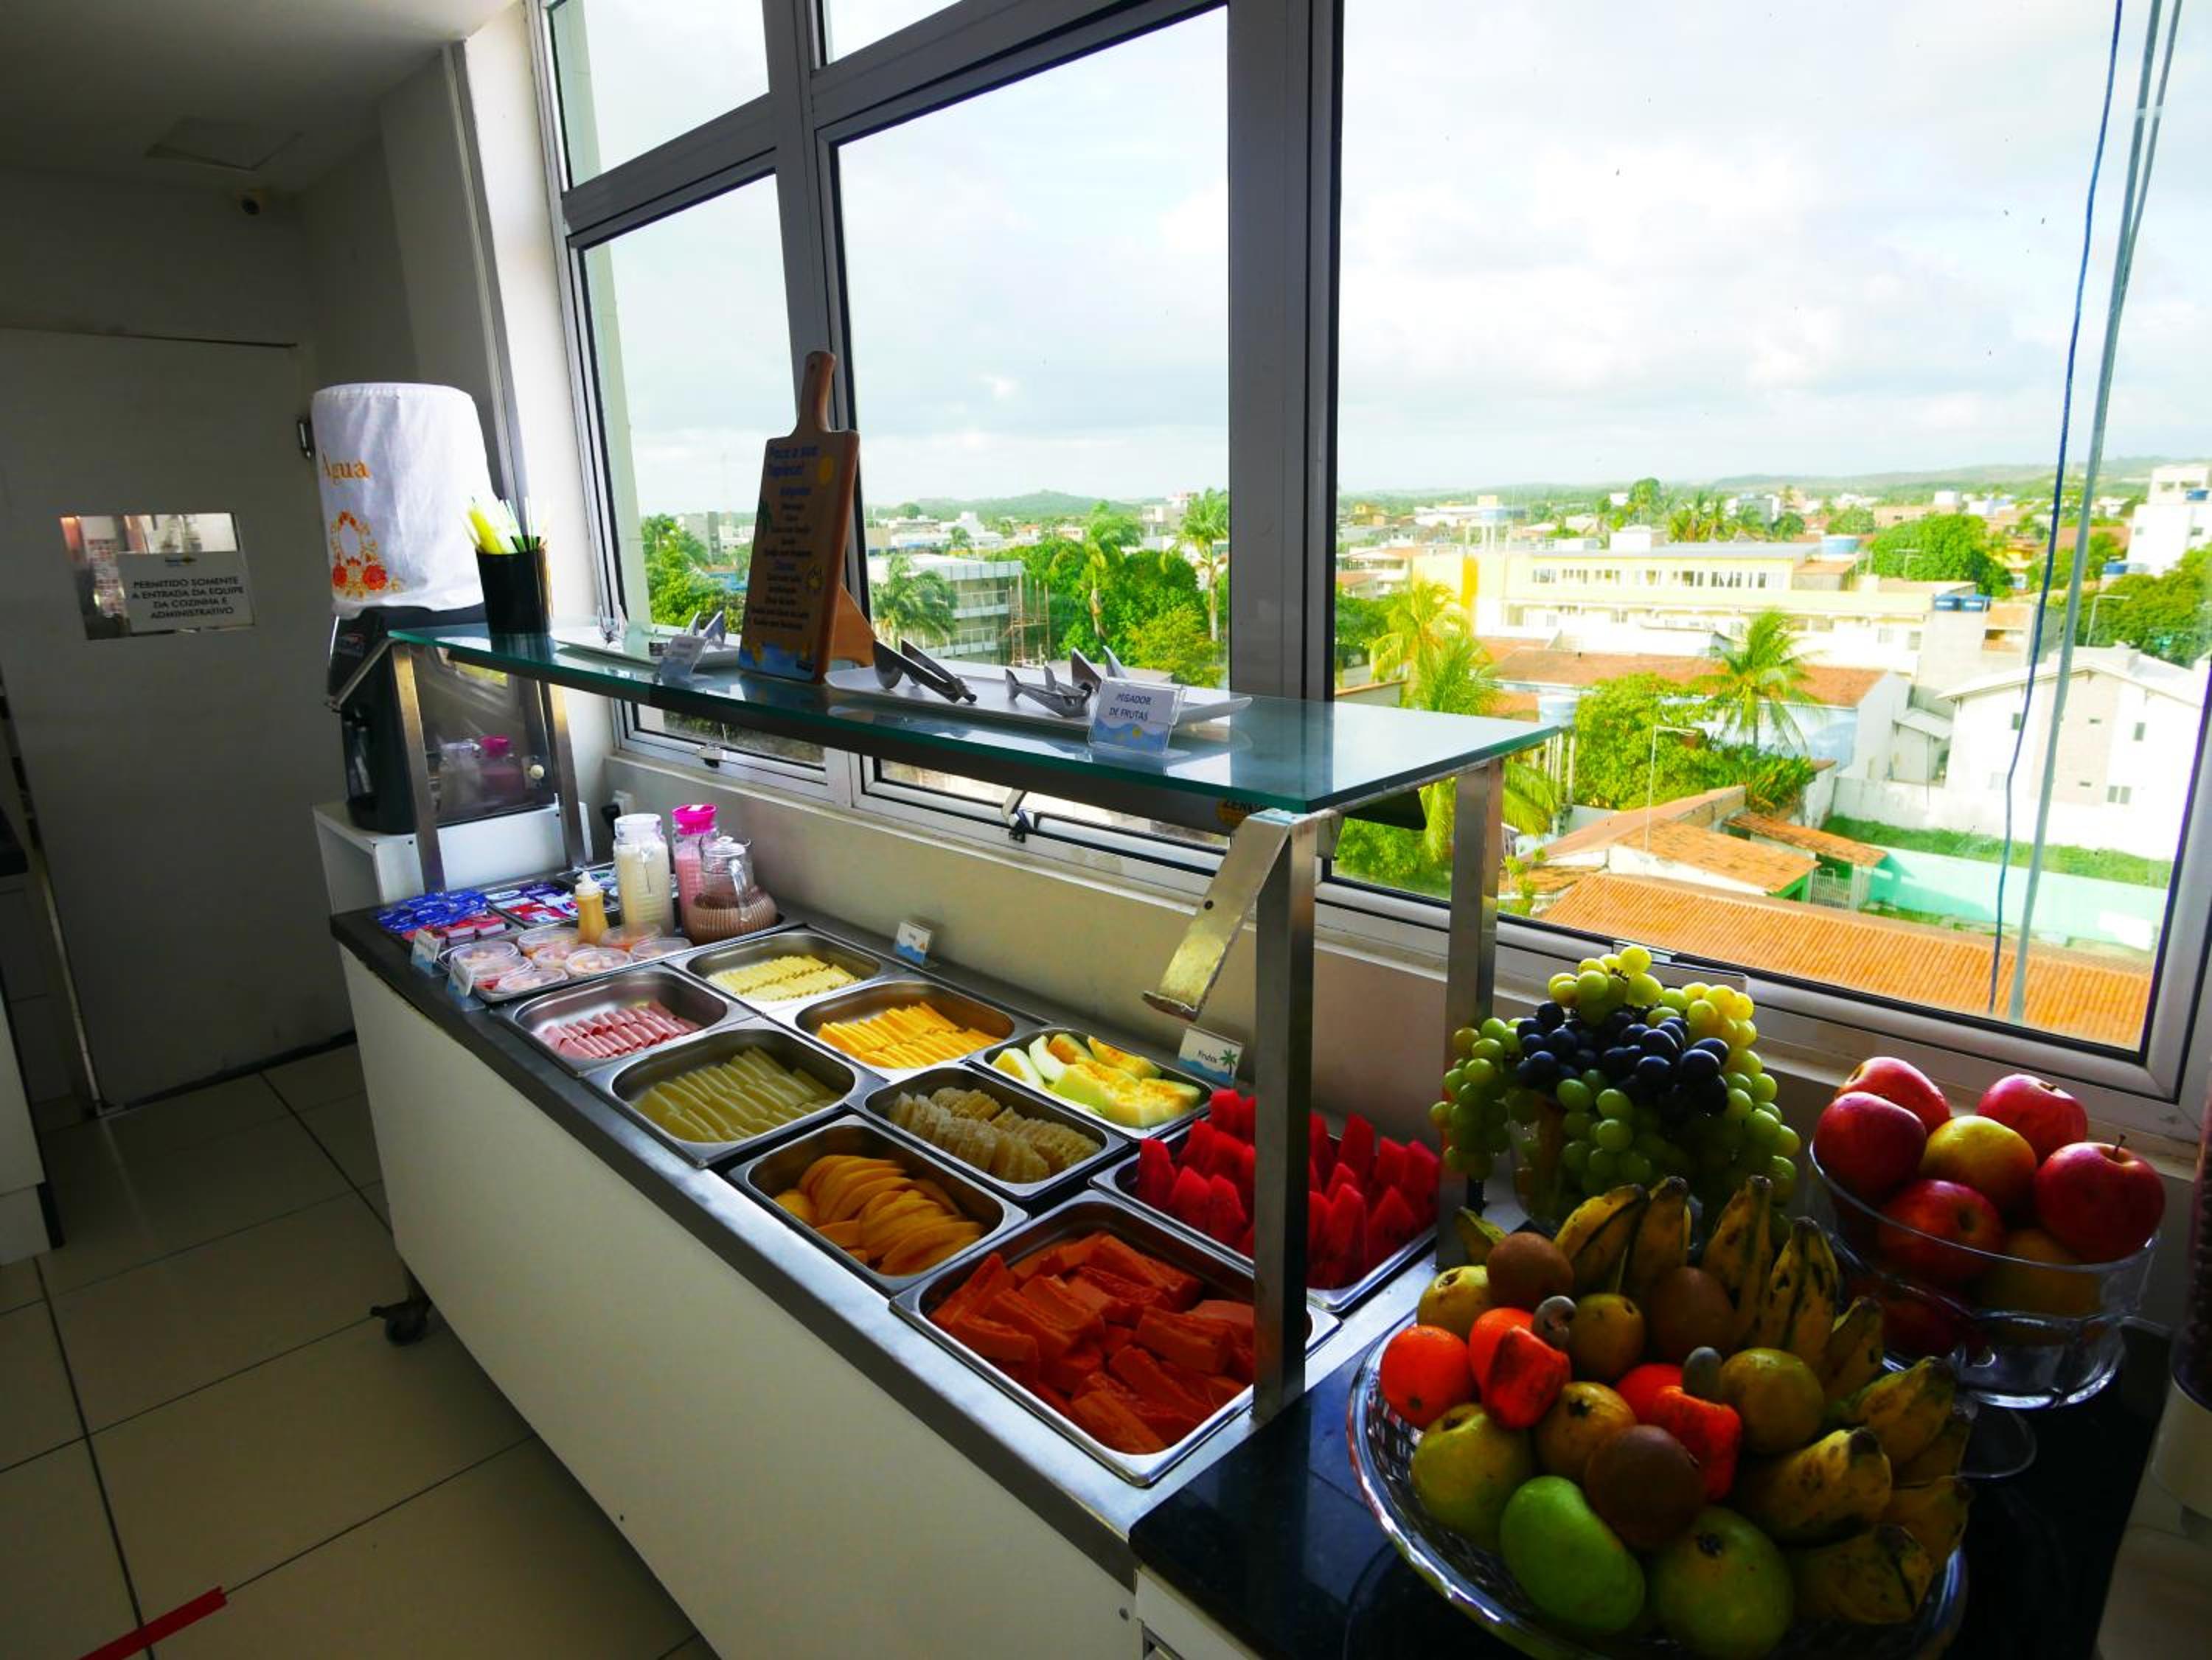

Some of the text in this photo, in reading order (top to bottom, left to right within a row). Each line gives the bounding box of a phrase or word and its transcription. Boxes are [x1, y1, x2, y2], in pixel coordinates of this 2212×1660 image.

[133, 576, 238, 588] PERMITIDO SOMENTE
[142, 589, 189, 599] ENTRADA
[192, 587, 205, 596] DA
[209, 586, 243, 596] EQUIPE
[153, 597, 228, 609] DA COZINHA E
[150, 606, 234, 619] ADMINISTRATIVO
[1109, 707, 1148, 721] DE FRUTAS
